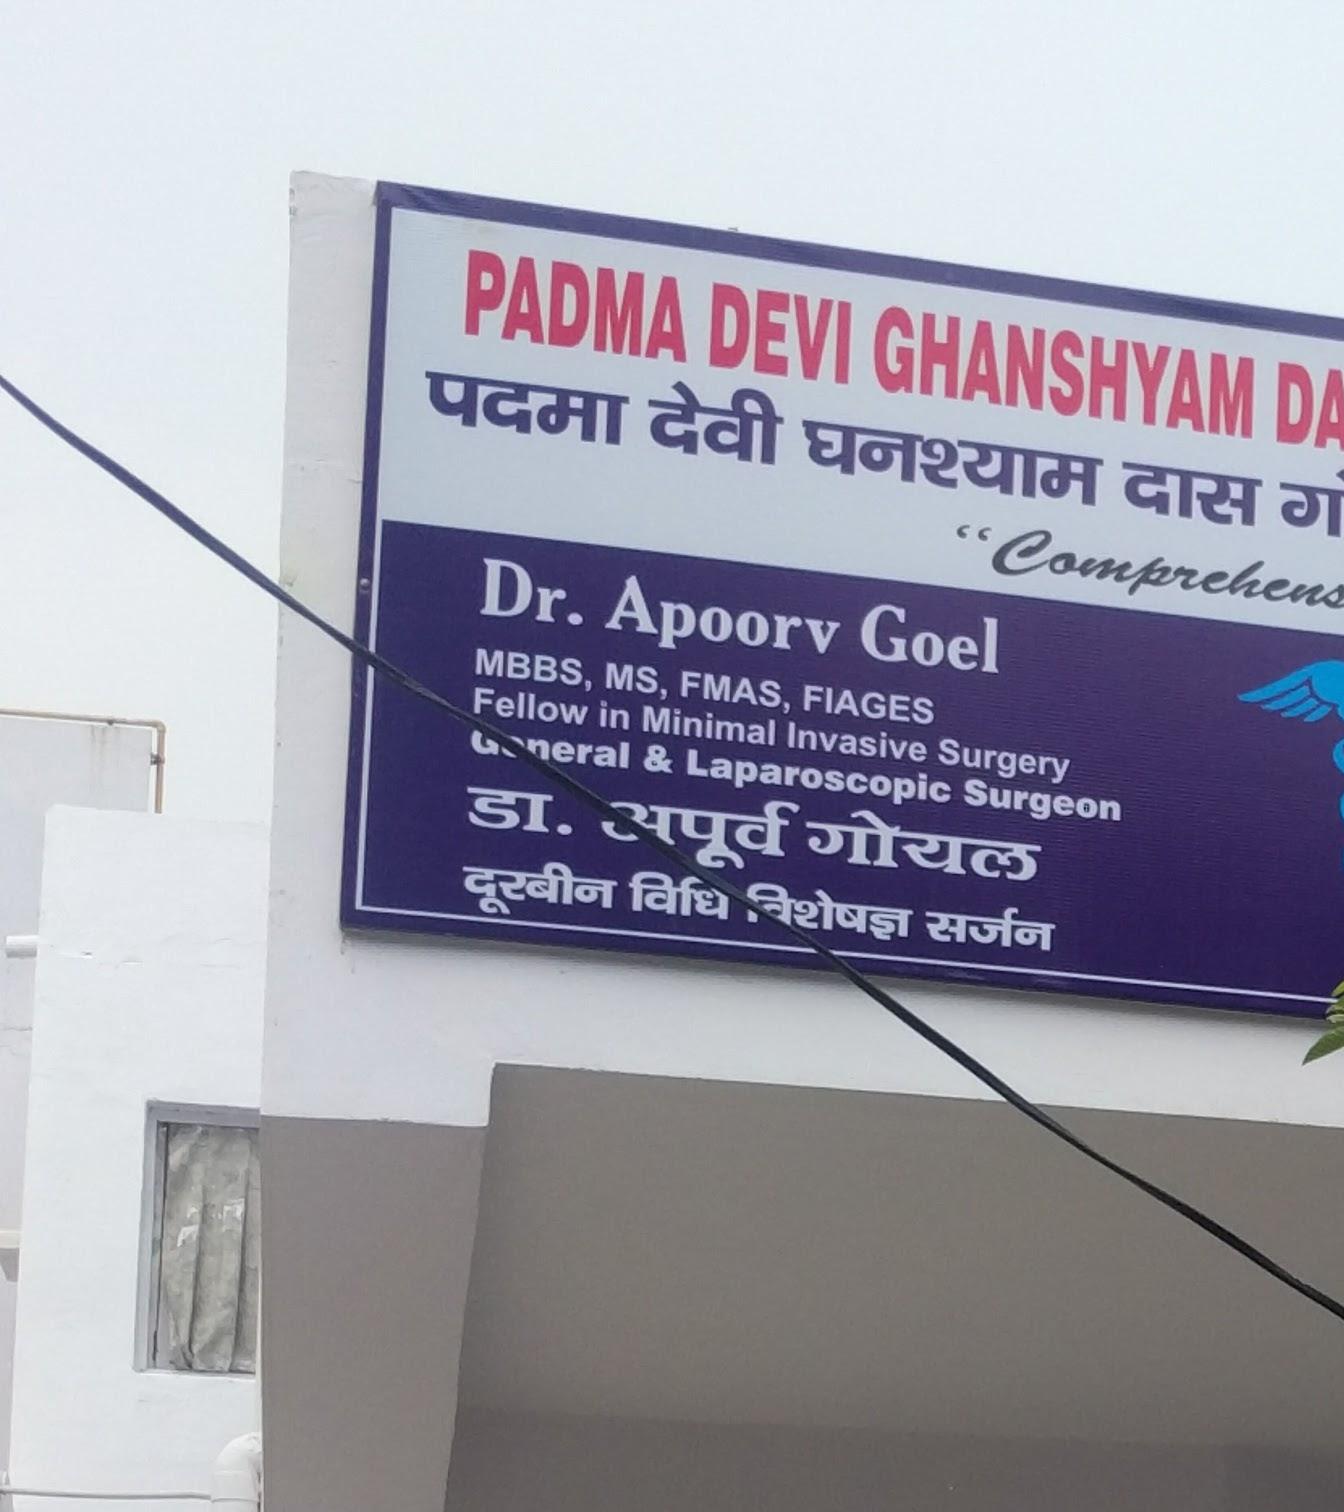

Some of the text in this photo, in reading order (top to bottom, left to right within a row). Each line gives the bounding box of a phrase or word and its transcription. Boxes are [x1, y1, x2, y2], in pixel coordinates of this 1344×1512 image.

[463, 249, 688, 363] PADMA
[708, 283, 852, 385] DEVI
[873, 305, 1255, 439] GHANSHYAM
[424, 370, 629, 445] पदमा
[648, 380, 784, 466] देवी
[800, 419, 1104, 507] घनश्याम
[1121, 461, 1263, 527] दास
[479, 557, 999, 675] Dr. Apoorv Goel
[475, 648, 935, 725] MBBS, MS, FMAS, FIAGES
[473, 687, 1070, 784] Fellow in Minimal Invasive Surgery
[643, 744, 673, 774] &
[687, 749, 952, 804] Laparoscopic
[964, 779, 1121, 821] Surgeon
[467, 787, 1042, 881] डा. अपूर्व गोयल
[462, 862, 1056, 951] दूरबीन विधि विशेषज्ञ सर्जन
